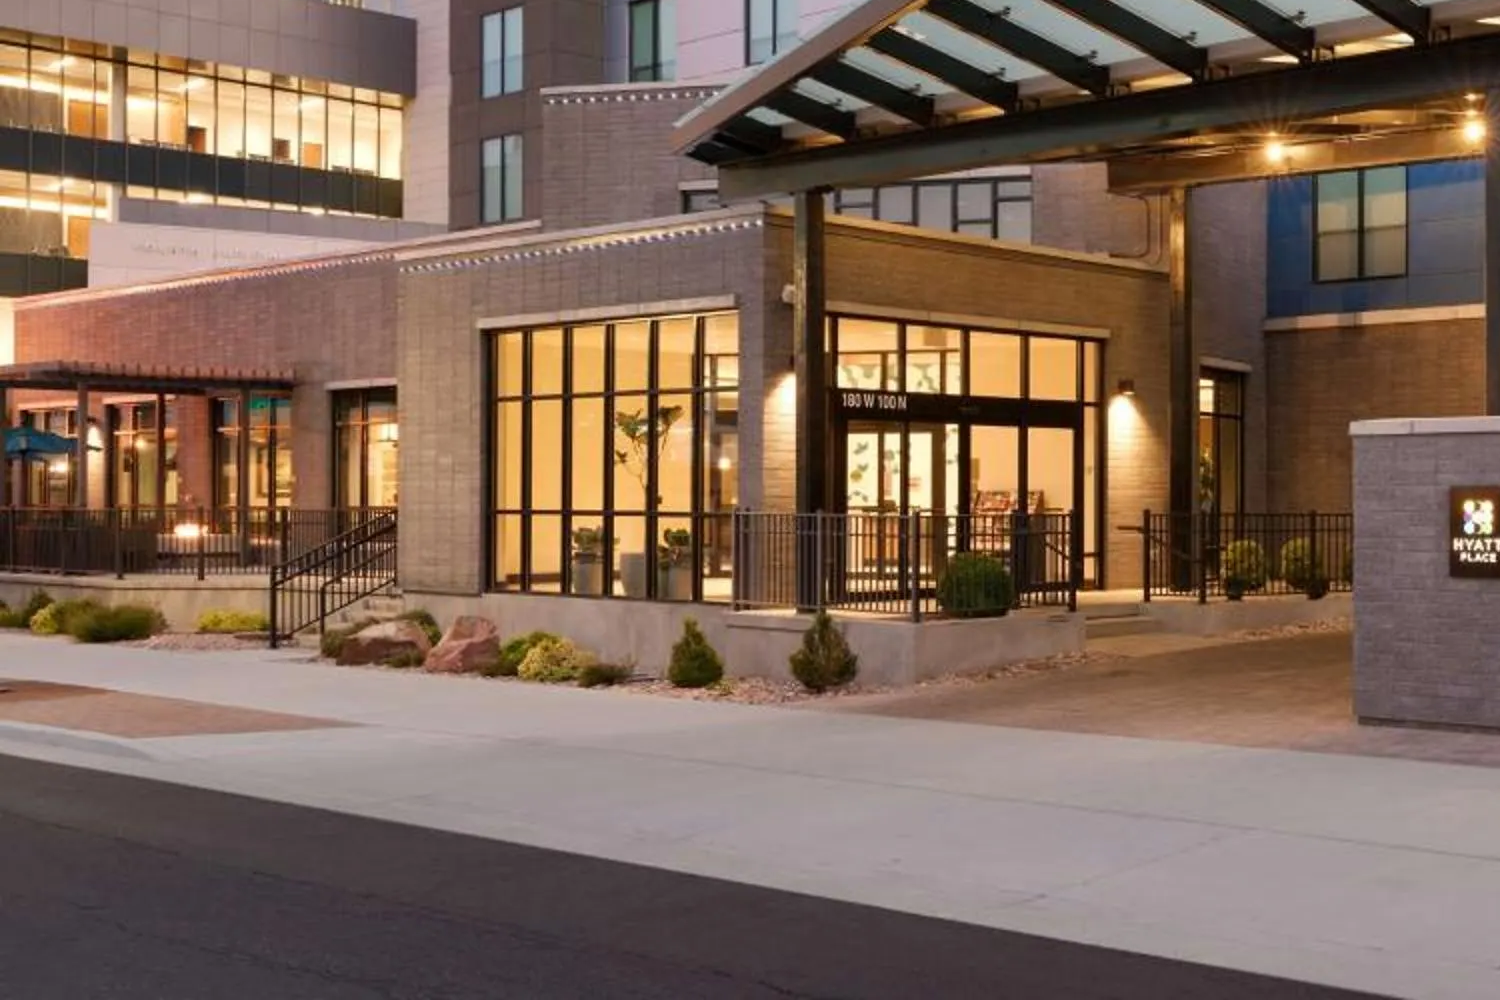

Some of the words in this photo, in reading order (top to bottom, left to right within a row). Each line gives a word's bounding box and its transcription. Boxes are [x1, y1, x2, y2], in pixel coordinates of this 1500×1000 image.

[842, 392, 861, 408] 180
[863, 392, 875, 409] W
[878, 394, 896, 410] 100
[897, 395, 907, 410] N
[1460, 551, 1497, 563] PLACE
